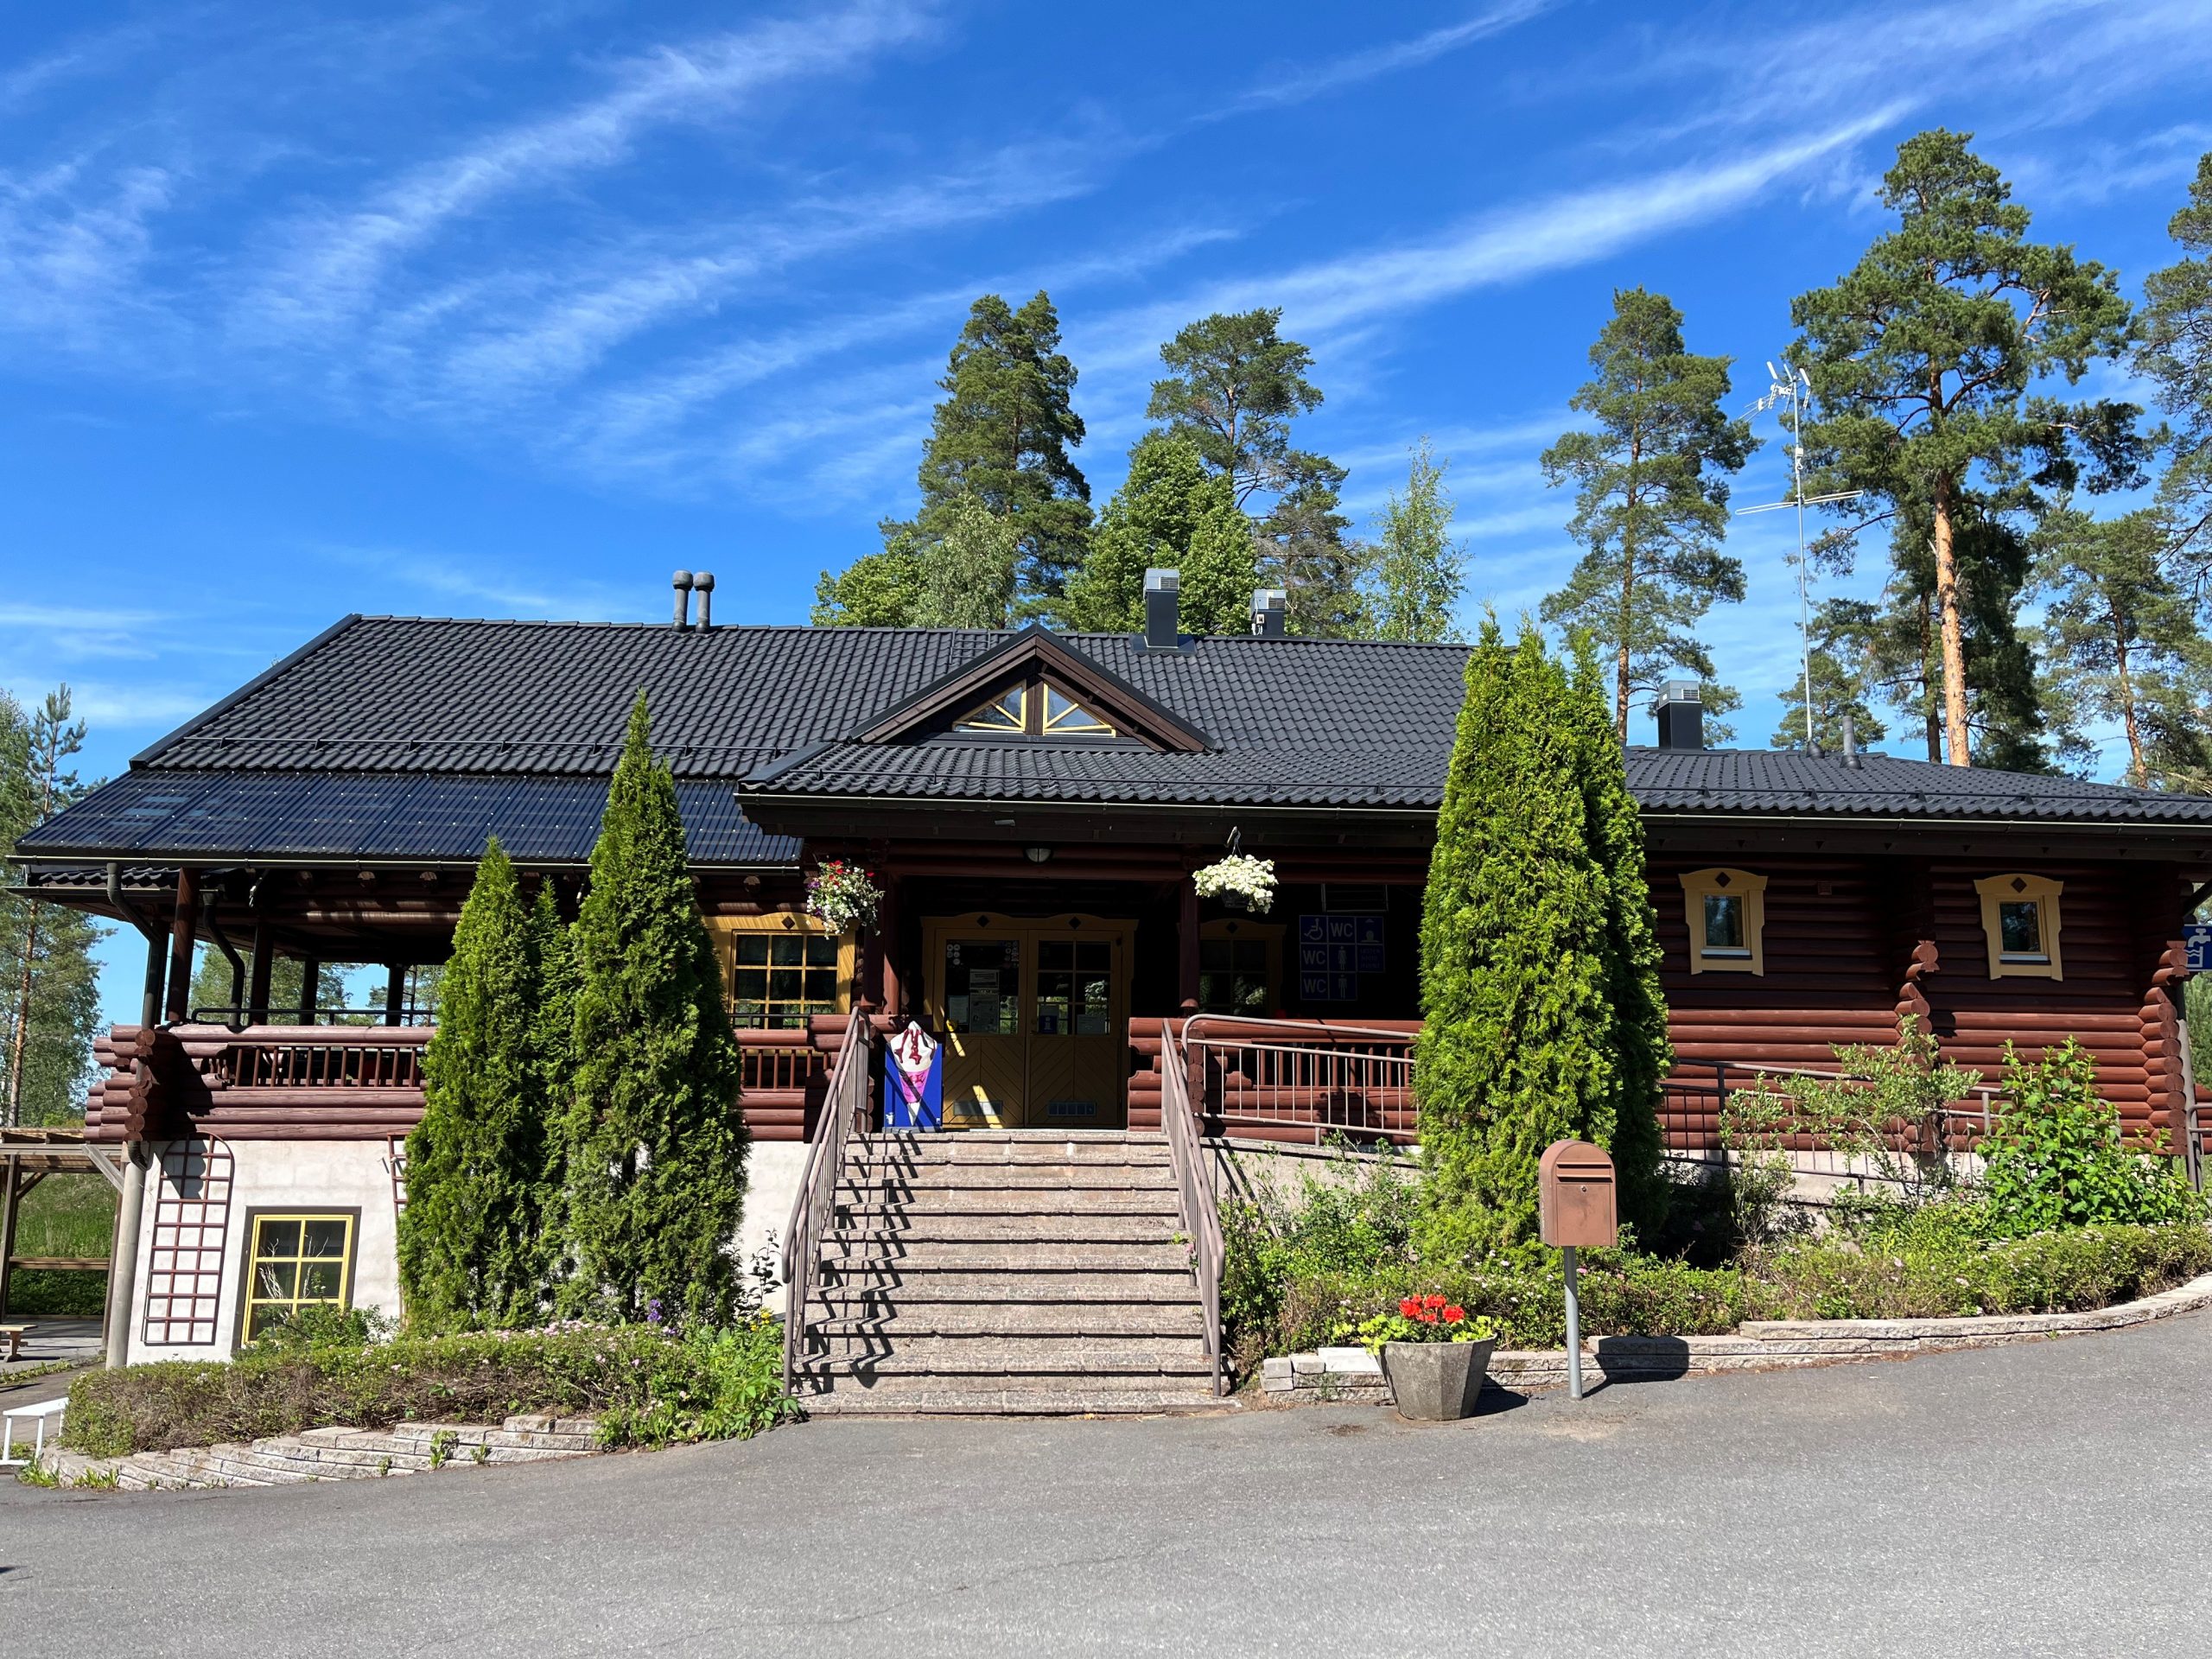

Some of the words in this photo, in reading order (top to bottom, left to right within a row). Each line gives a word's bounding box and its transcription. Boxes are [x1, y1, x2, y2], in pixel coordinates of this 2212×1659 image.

[1330, 922, 1353, 938] WC
[1302, 949, 1325, 965] WC
[1303, 978, 1326, 994] WC
